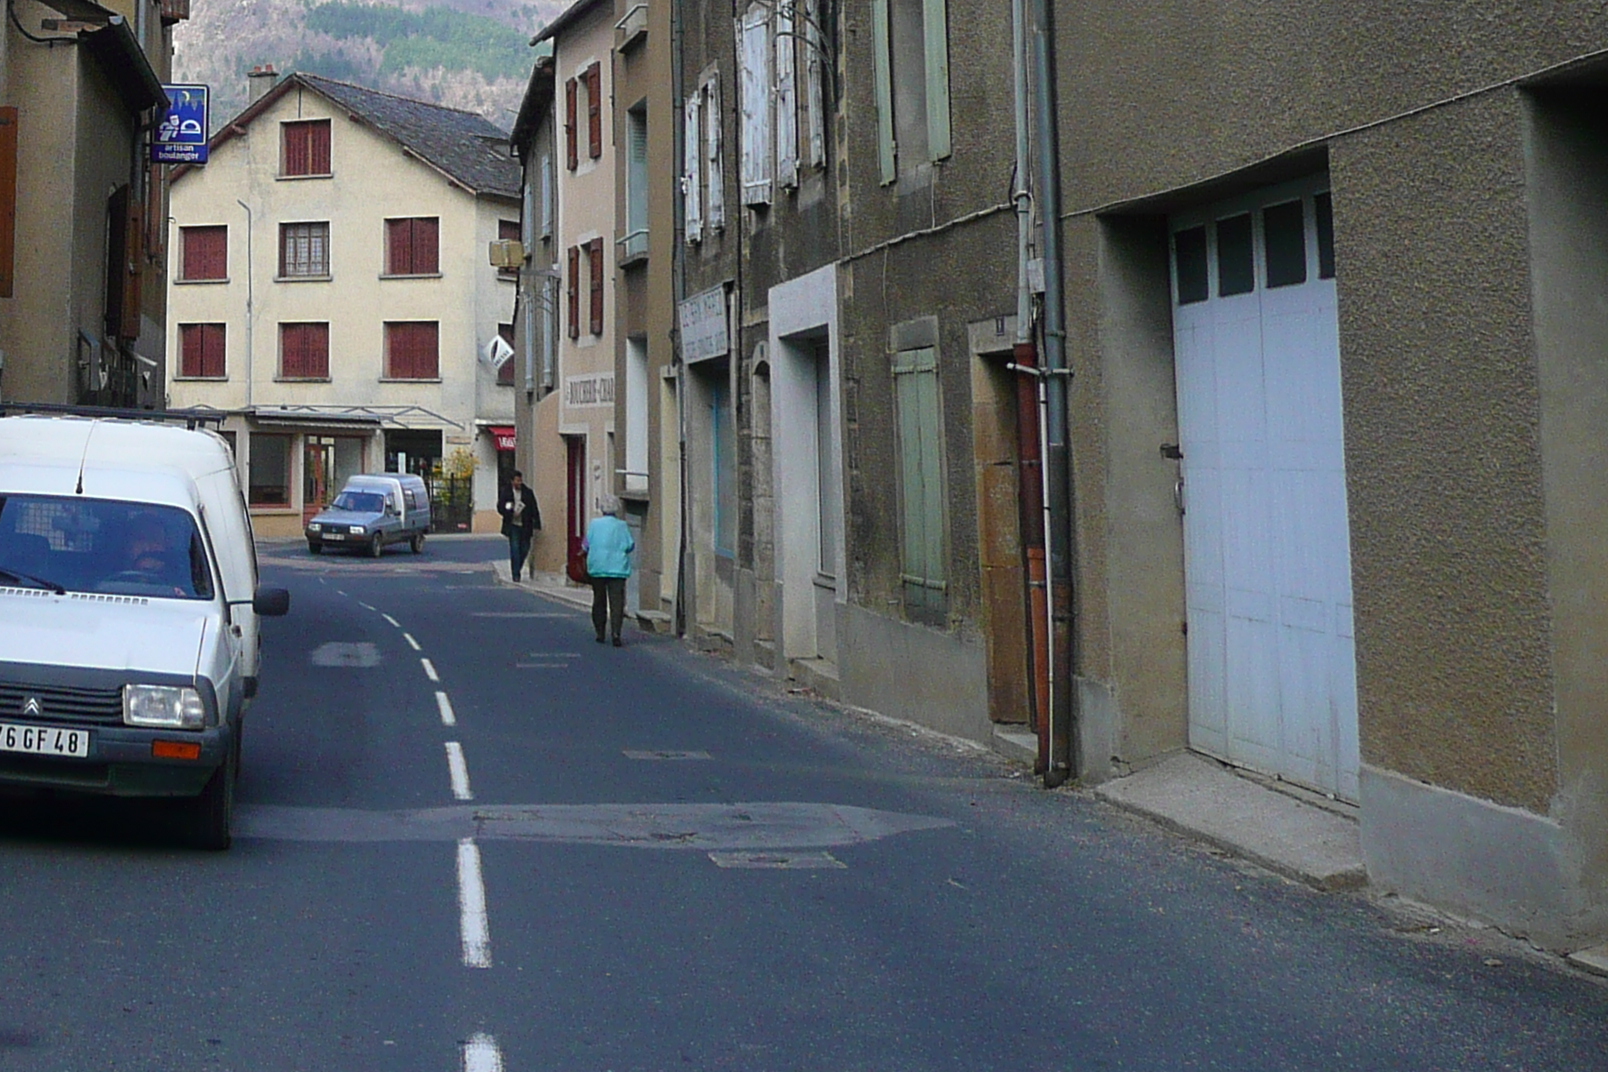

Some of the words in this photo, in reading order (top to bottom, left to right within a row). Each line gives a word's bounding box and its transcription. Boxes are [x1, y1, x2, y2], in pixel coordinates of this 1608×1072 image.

[159, 152, 199, 161] boulanger
[23, 728, 48, 751] GF
[54, 730, 79, 754] 48
